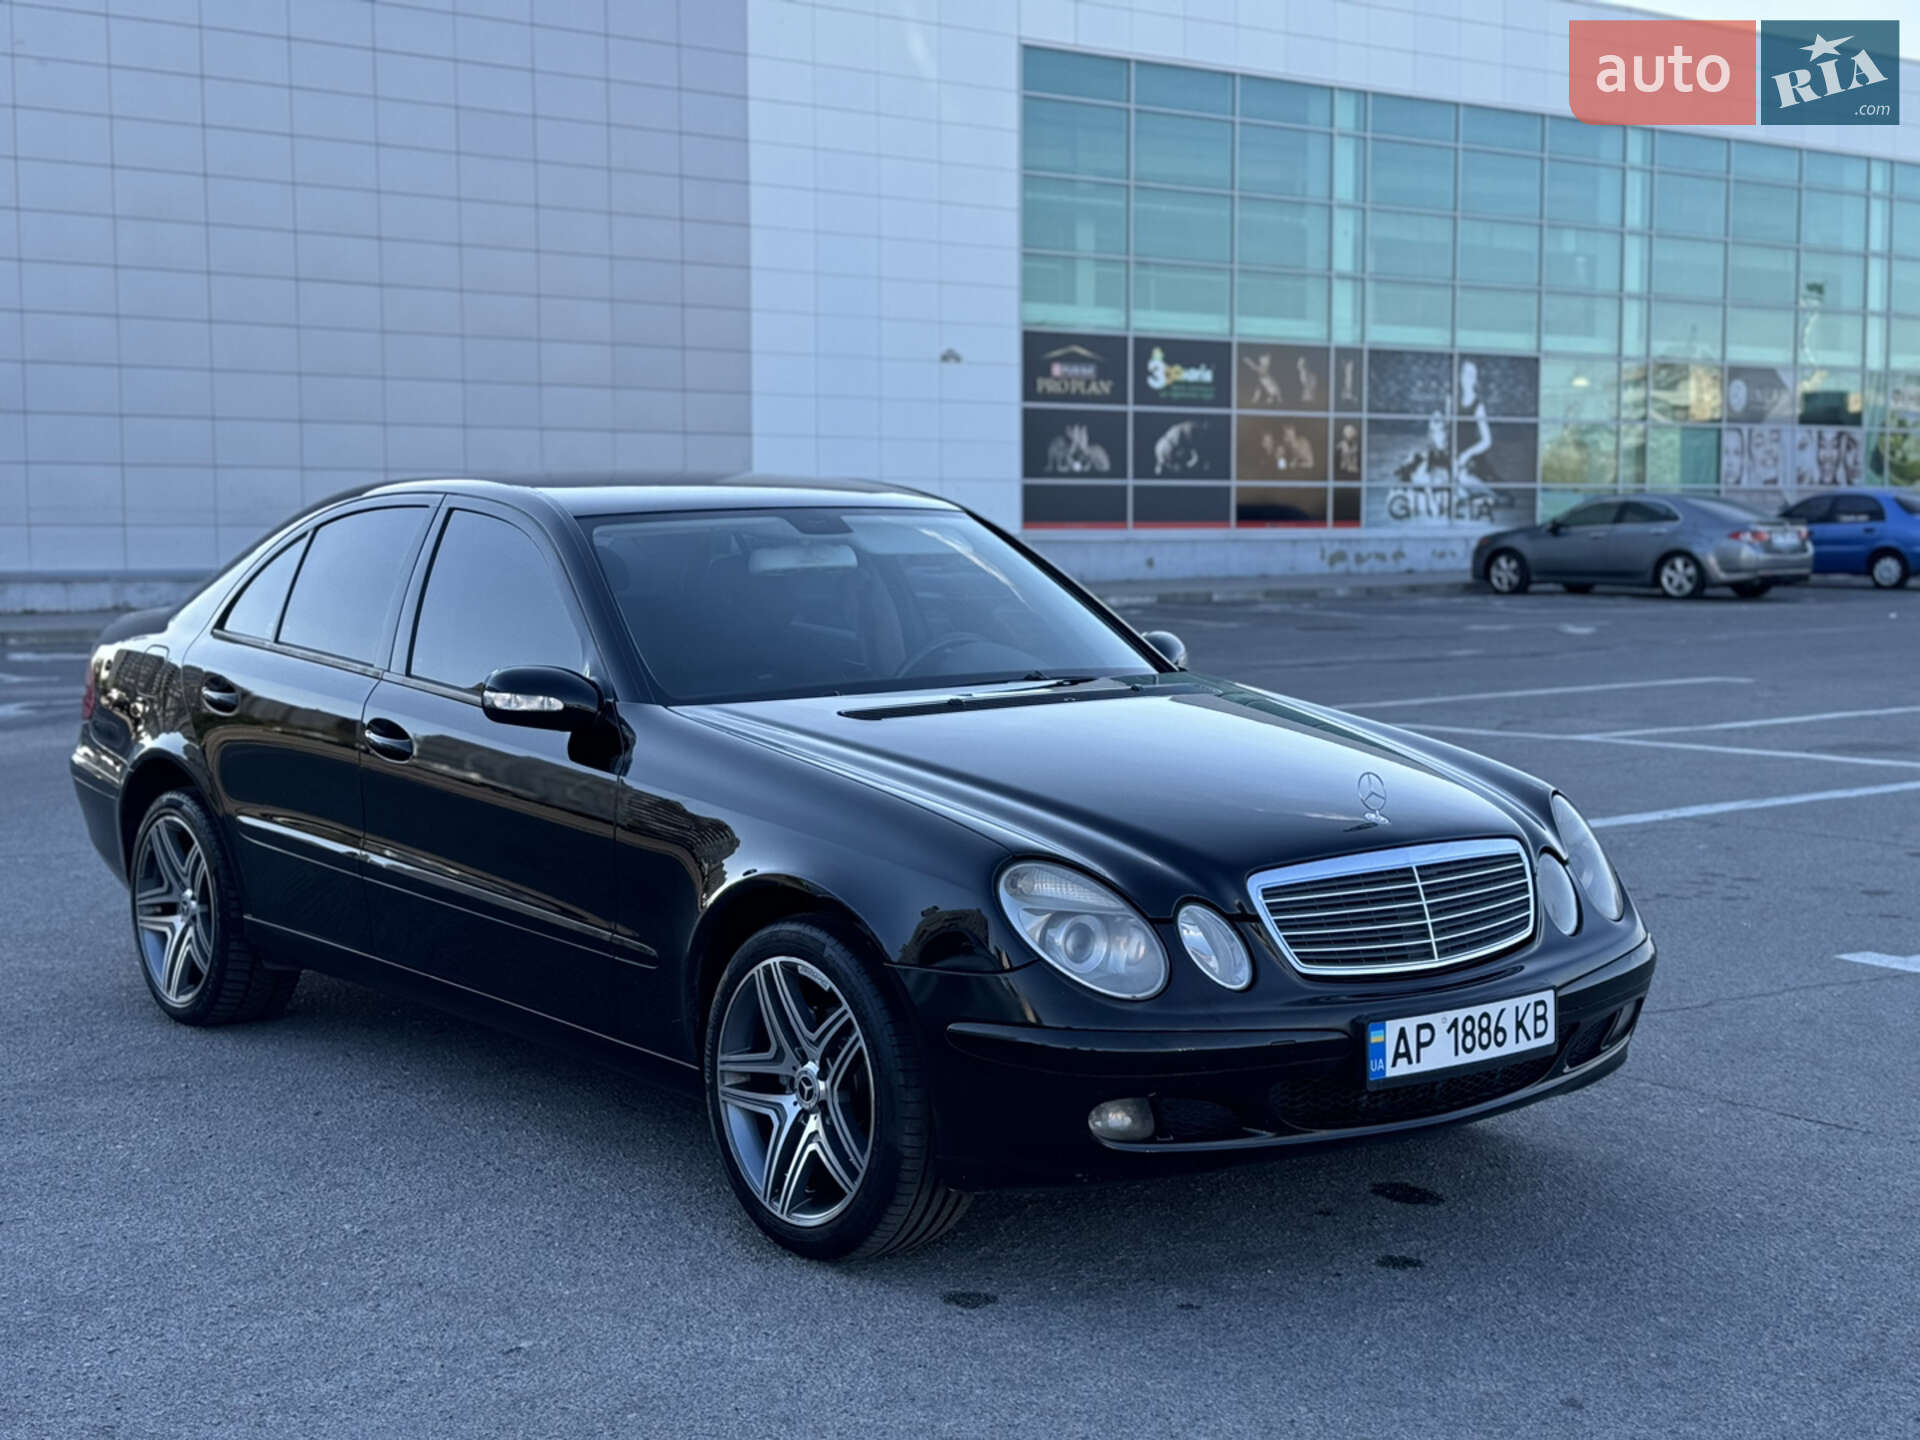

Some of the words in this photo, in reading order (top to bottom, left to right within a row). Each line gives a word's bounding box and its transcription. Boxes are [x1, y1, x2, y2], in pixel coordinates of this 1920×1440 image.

[1391, 1022, 1436, 1068] AP
[1446, 1008, 1508, 1057] 1886
[1515, 999, 1549, 1045] KB
[1370, 1058, 1385, 1073] UA
